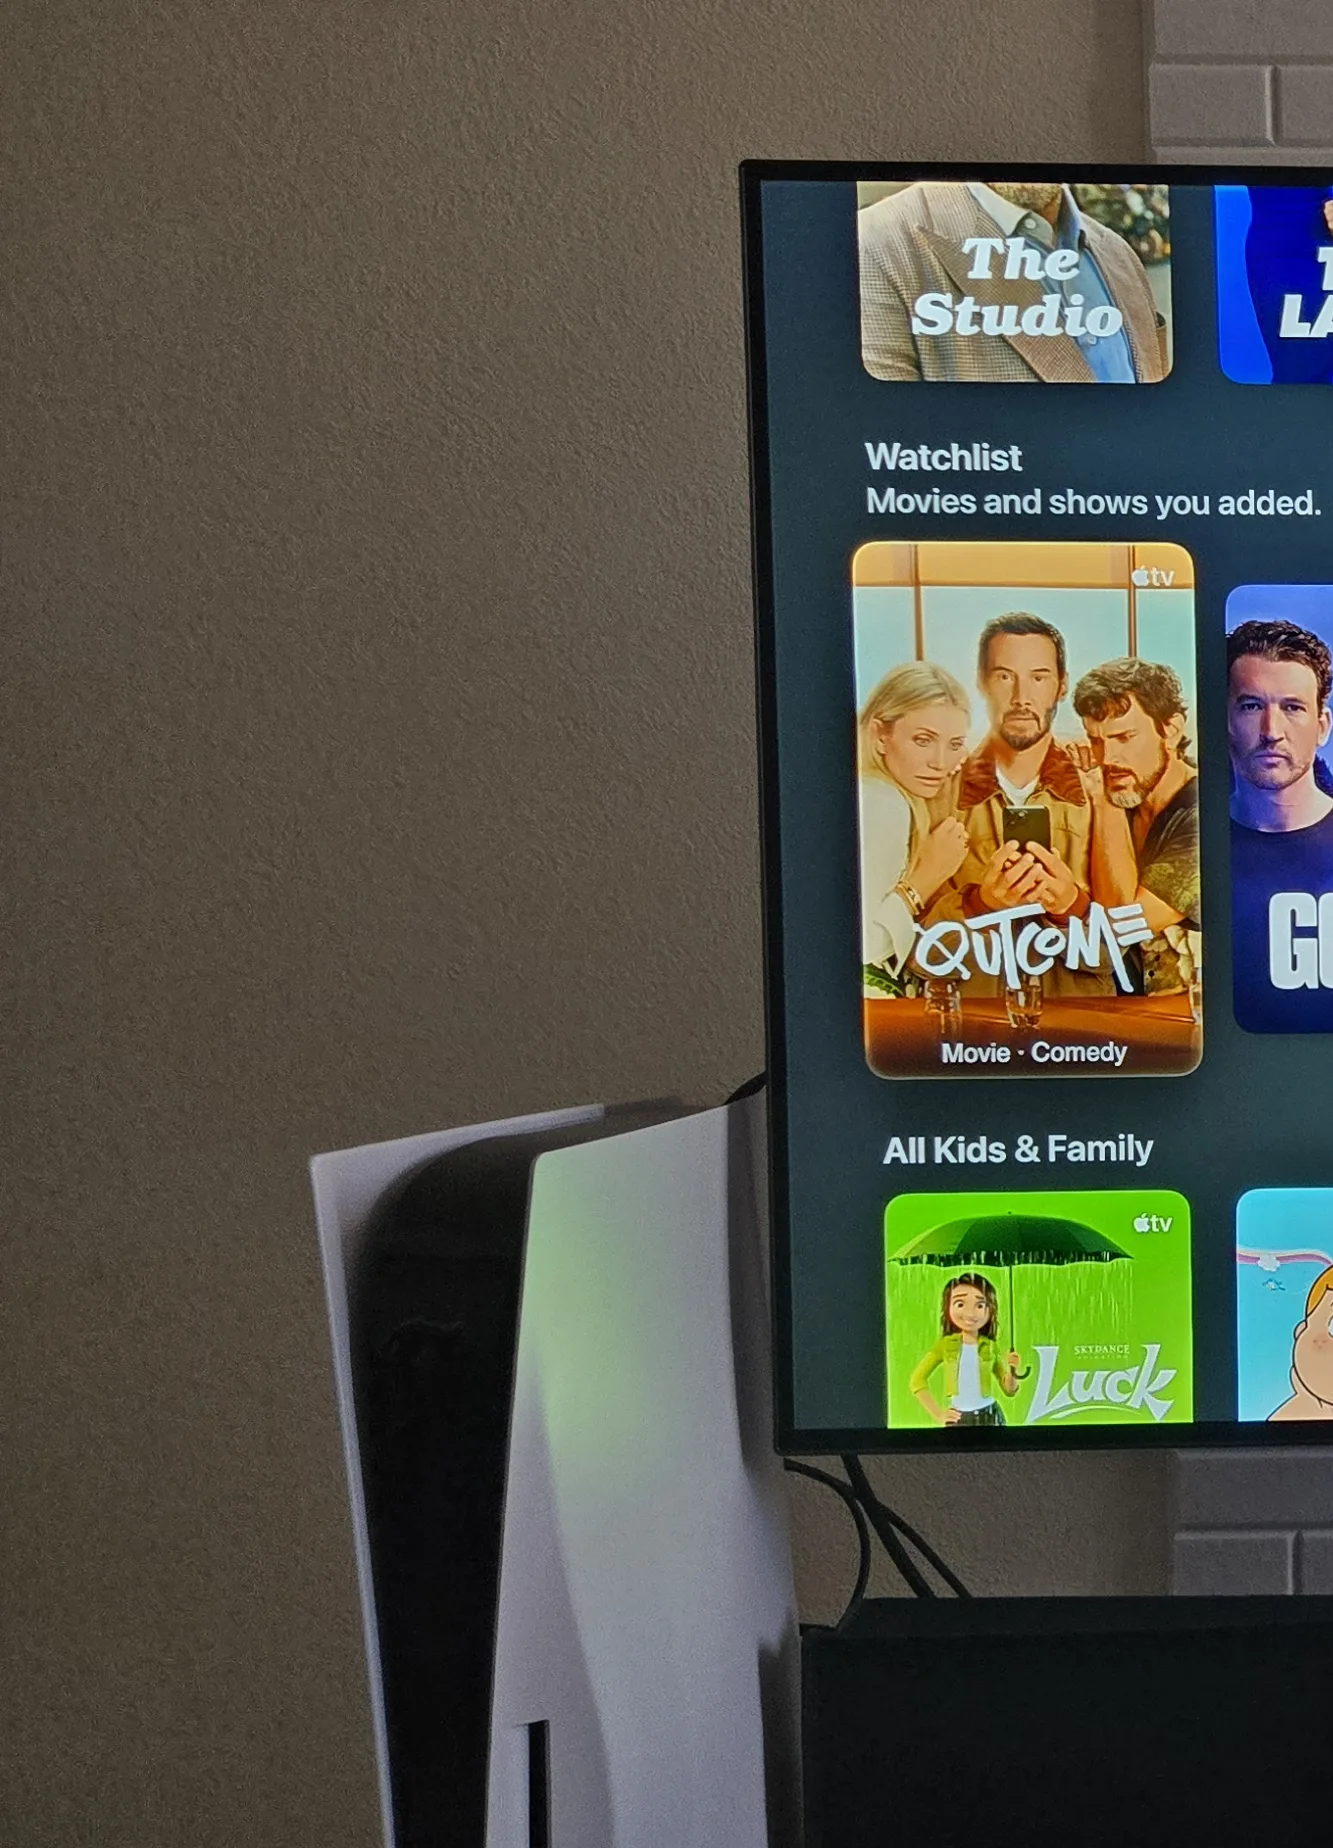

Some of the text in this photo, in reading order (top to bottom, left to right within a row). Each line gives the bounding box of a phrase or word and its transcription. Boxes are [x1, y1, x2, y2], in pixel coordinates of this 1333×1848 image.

[961, 237, 1080, 281] The
[911, 292, 1124, 338] Studio
[865, 442, 1023, 472] Watchlist
[866, 488, 1322, 520] Movies and shows you added.
[1151, 567, 1175, 587] tv
[942, 1041, 1128, 1067] Movie Comedy
[882, 1133, 1154, 1167] All Kids & Family
[1150, 1213, 1173, 1232] tv
[1074, 1344, 1130, 1355] SKYDANCE
[1024, 1344, 1177, 1423] Luck
